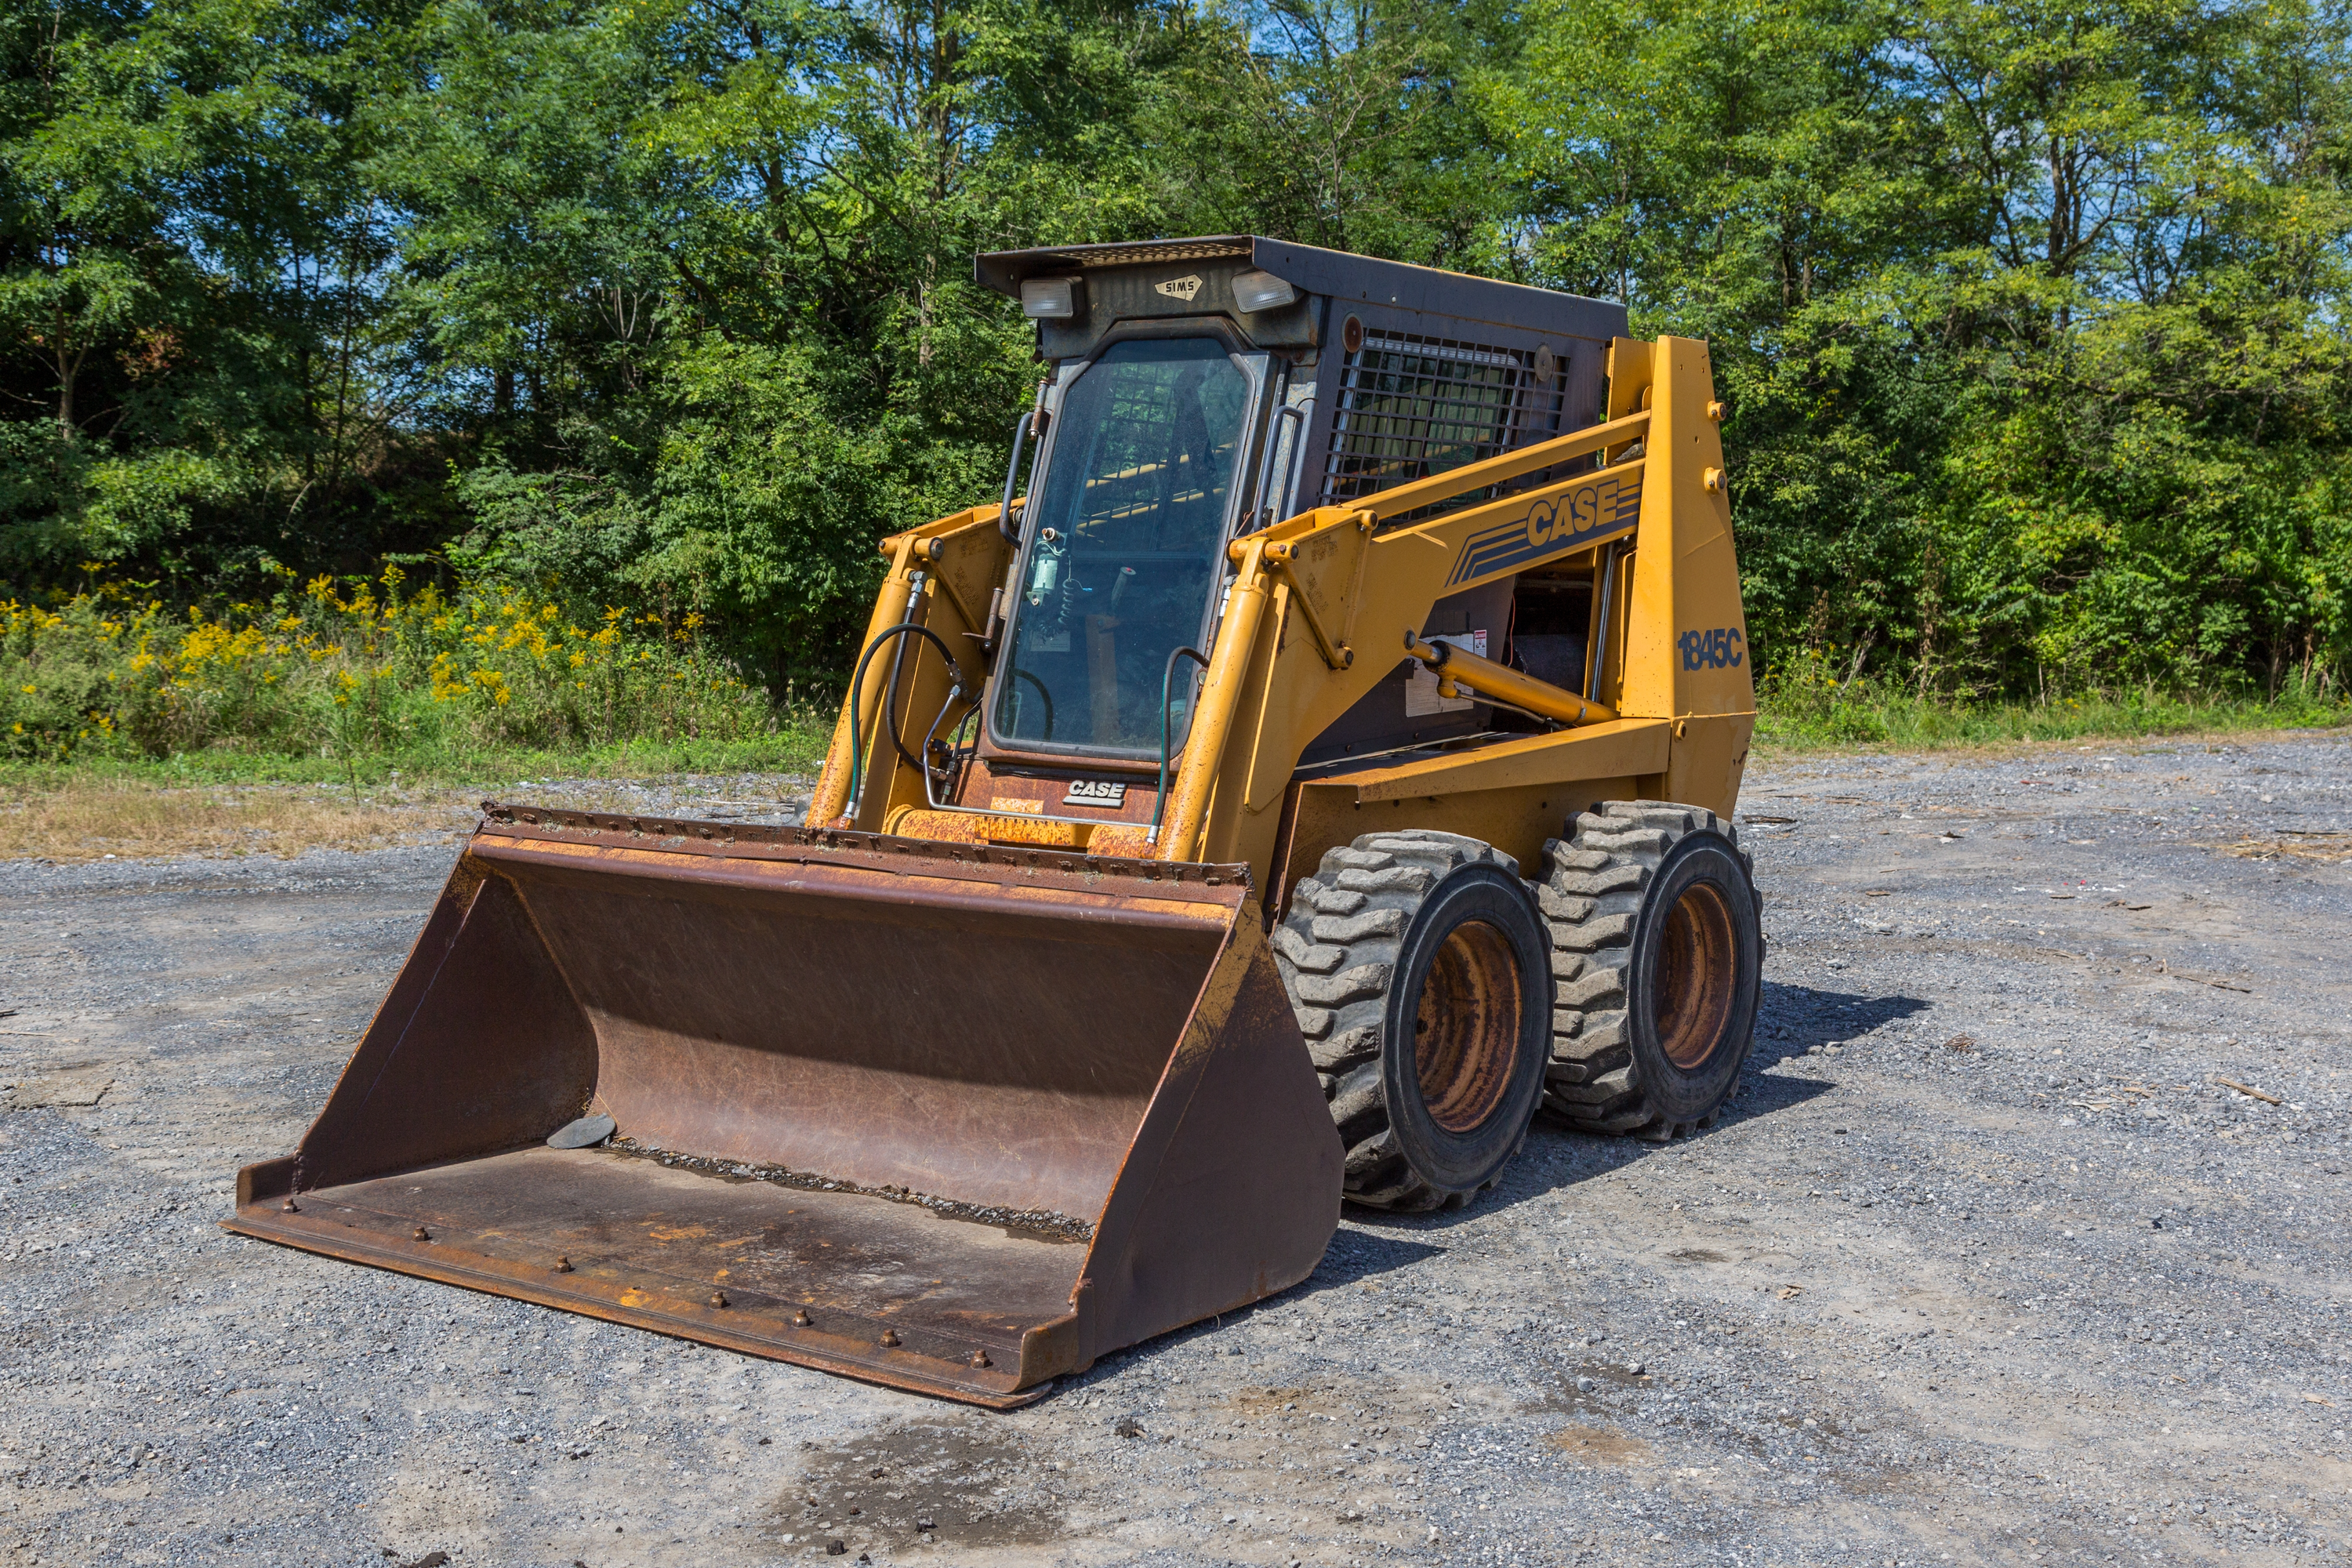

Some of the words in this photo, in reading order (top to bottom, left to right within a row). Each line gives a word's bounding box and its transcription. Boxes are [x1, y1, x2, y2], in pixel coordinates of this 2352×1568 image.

[1166, 281, 1194, 292] SIMS
[1527, 479, 1619, 546] CASE
[1678, 627, 1742, 671] 1845C
[1069, 780, 1125, 798] CASE
